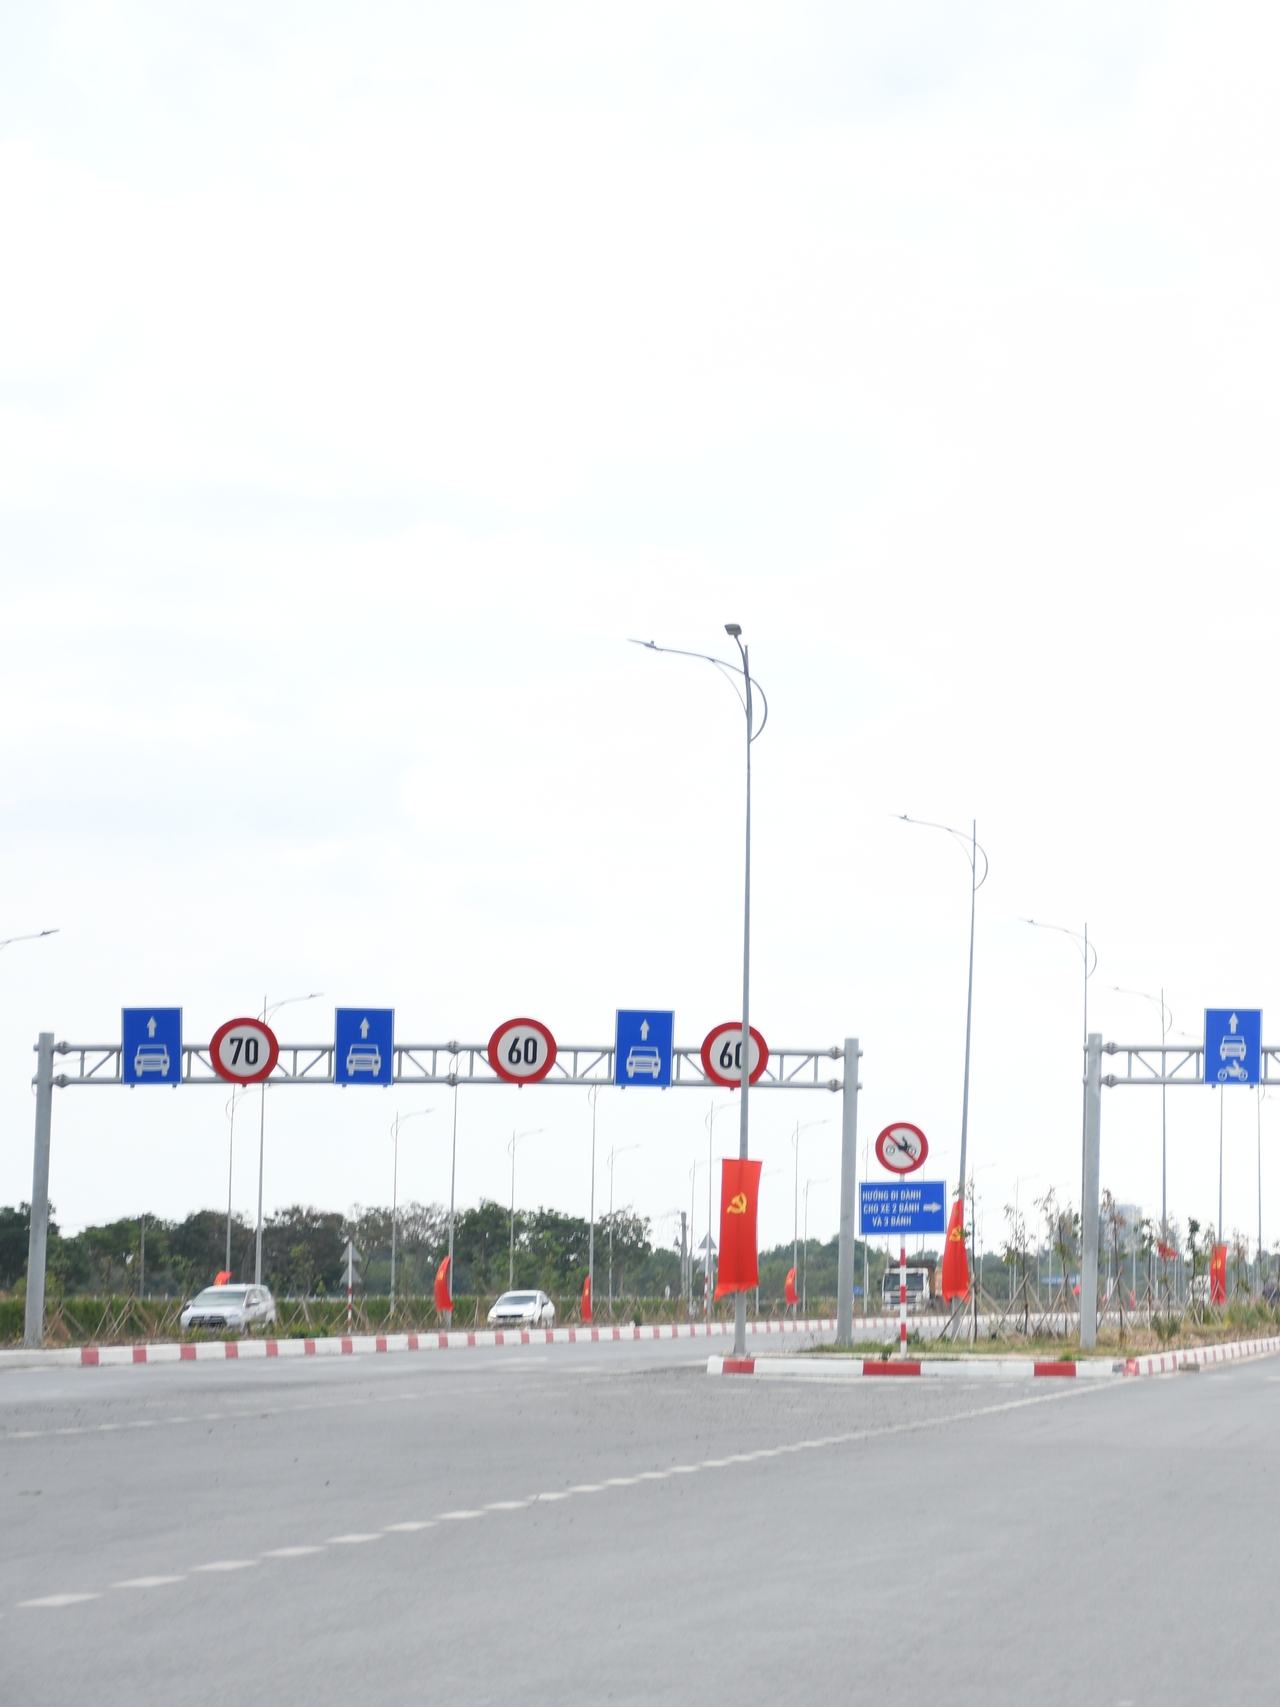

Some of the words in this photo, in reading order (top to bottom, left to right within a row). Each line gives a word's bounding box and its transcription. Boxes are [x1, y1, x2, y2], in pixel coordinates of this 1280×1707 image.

[229, 1037, 259, 1067] 70
[508, 1037, 537, 1066] 60
[863, 1203, 878, 1214] CHO
[881, 1203, 890, 1214] XE
[892, 1203, 897, 1214] 2
[899, 1201, 919, 1213] BÁNH
[872, 1214, 882, 1227] VÀ
[884, 1216, 888, 1227] 3
[891, 1214, 911, 1227] BÁNH
